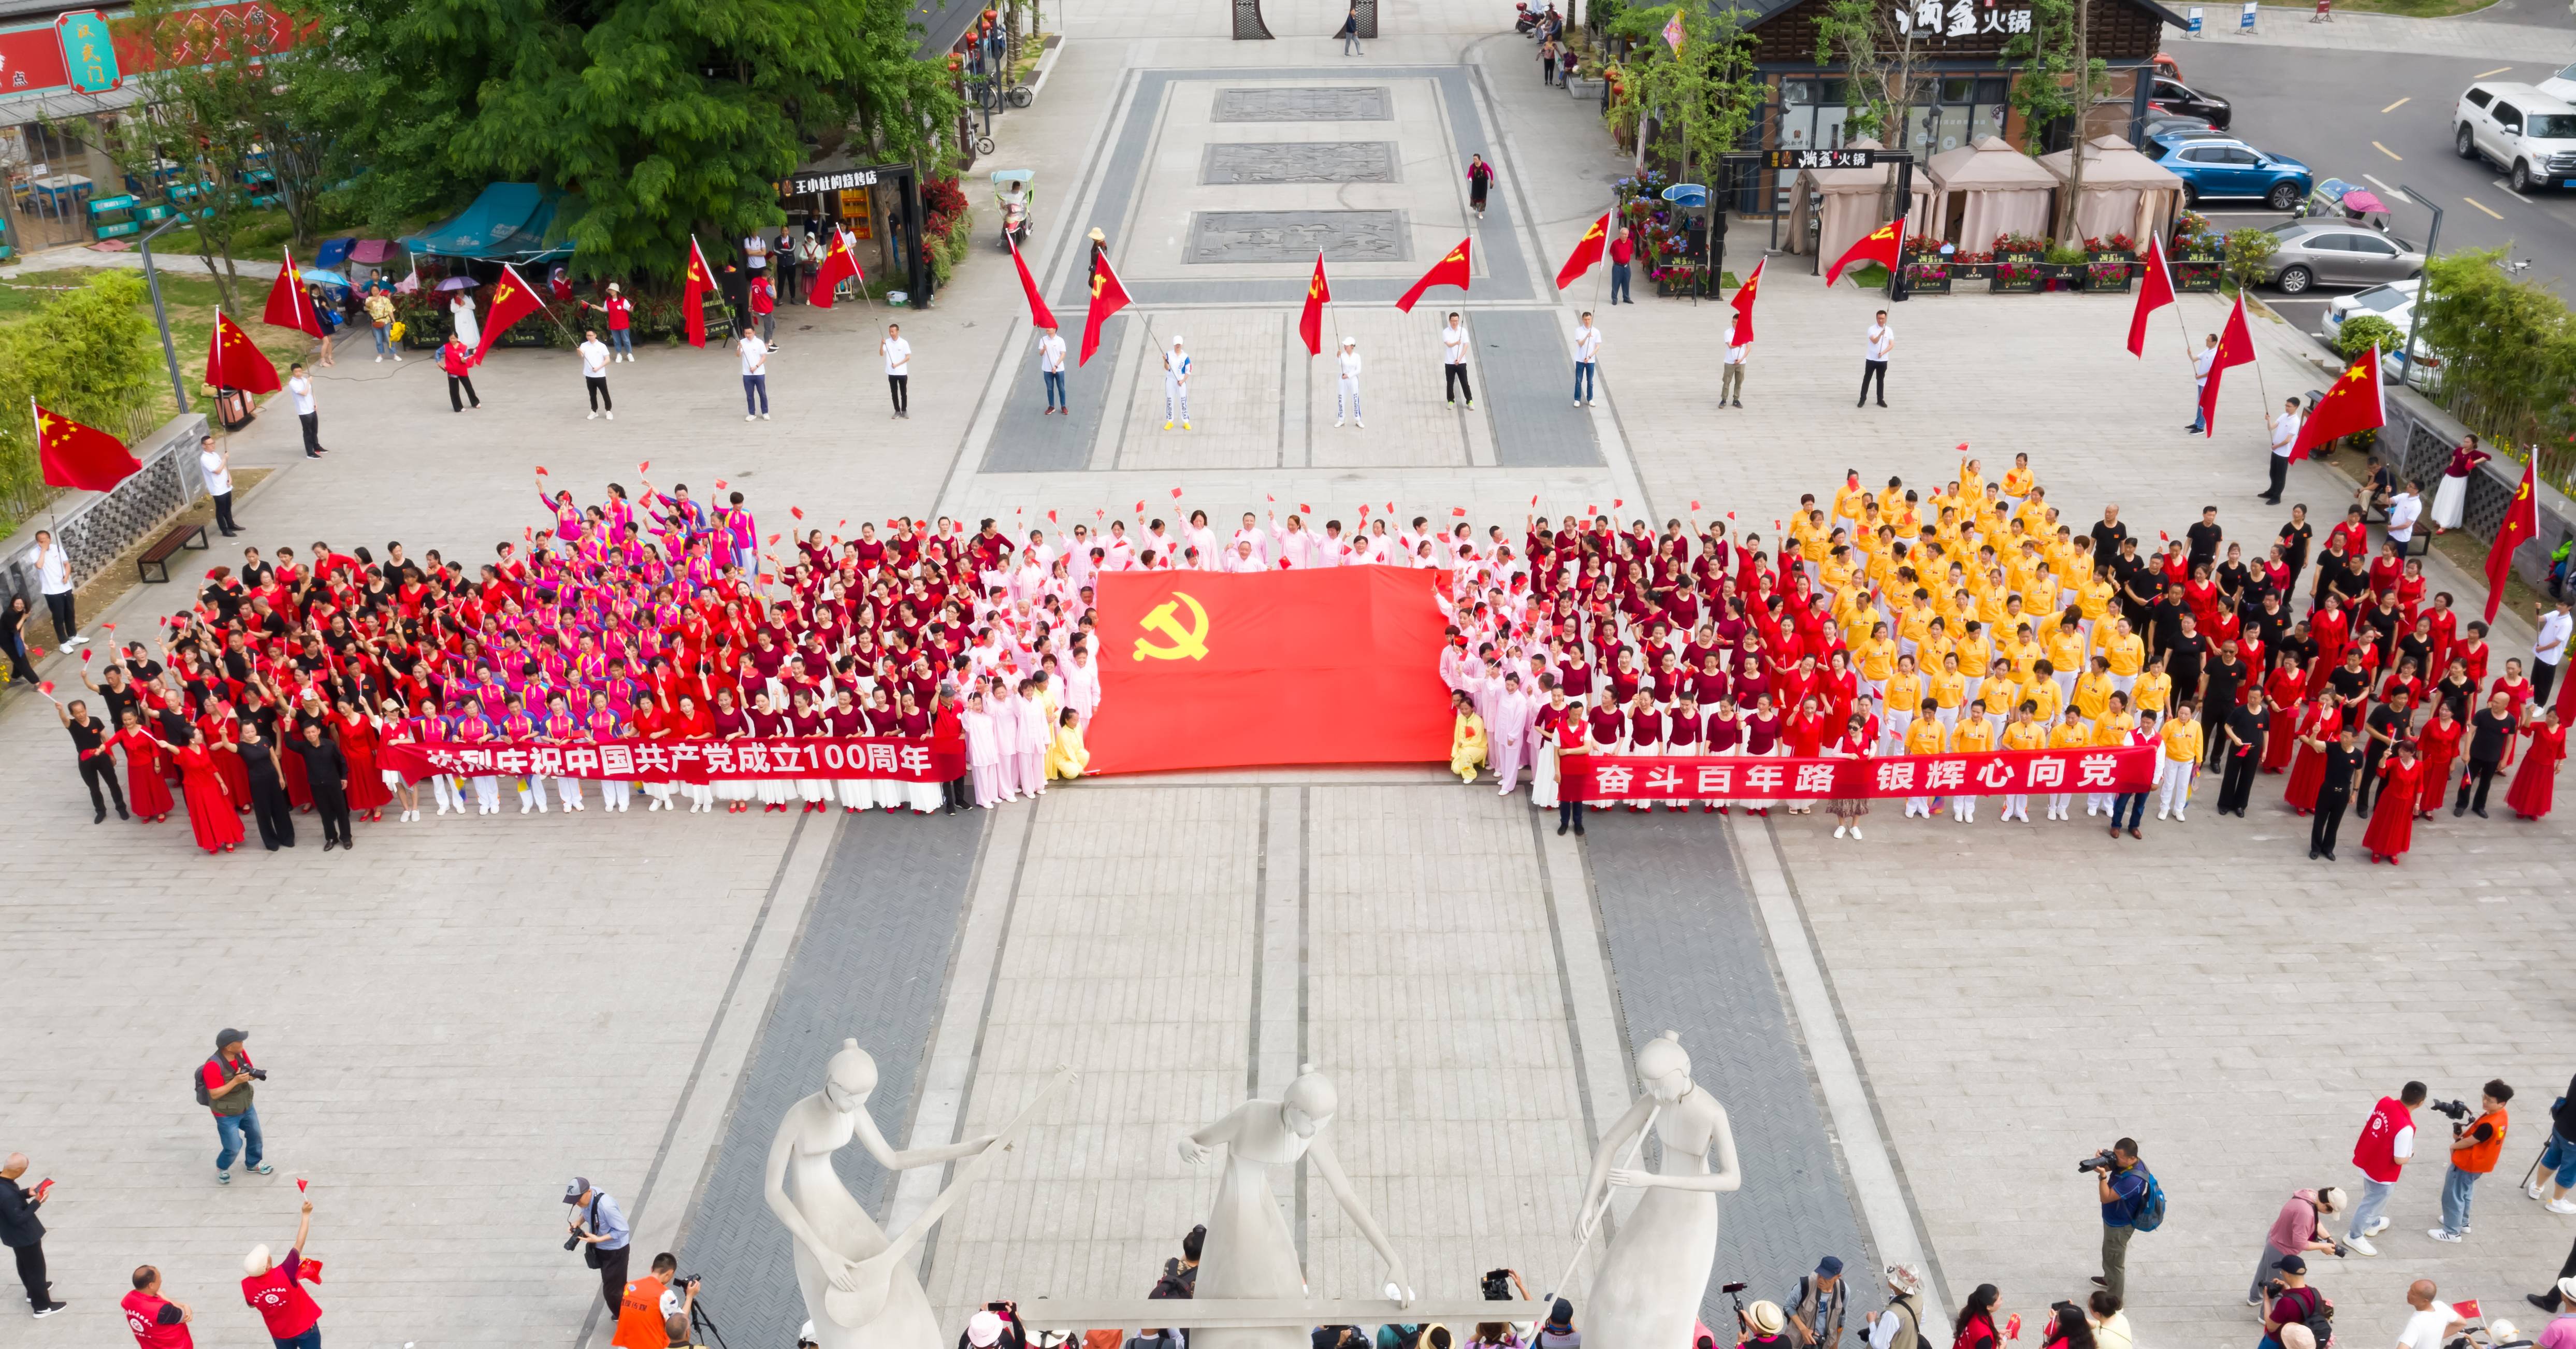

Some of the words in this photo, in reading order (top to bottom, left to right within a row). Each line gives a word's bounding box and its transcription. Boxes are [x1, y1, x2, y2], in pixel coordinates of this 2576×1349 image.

[77, 24, 105, 83] 汉武门
[795, 170, 877, 194] 王小杜的烧烤店
[1596, 764, 1835, 794] 奋斗百年路
[1876, 754, 2117, 792] 银辉心向党
